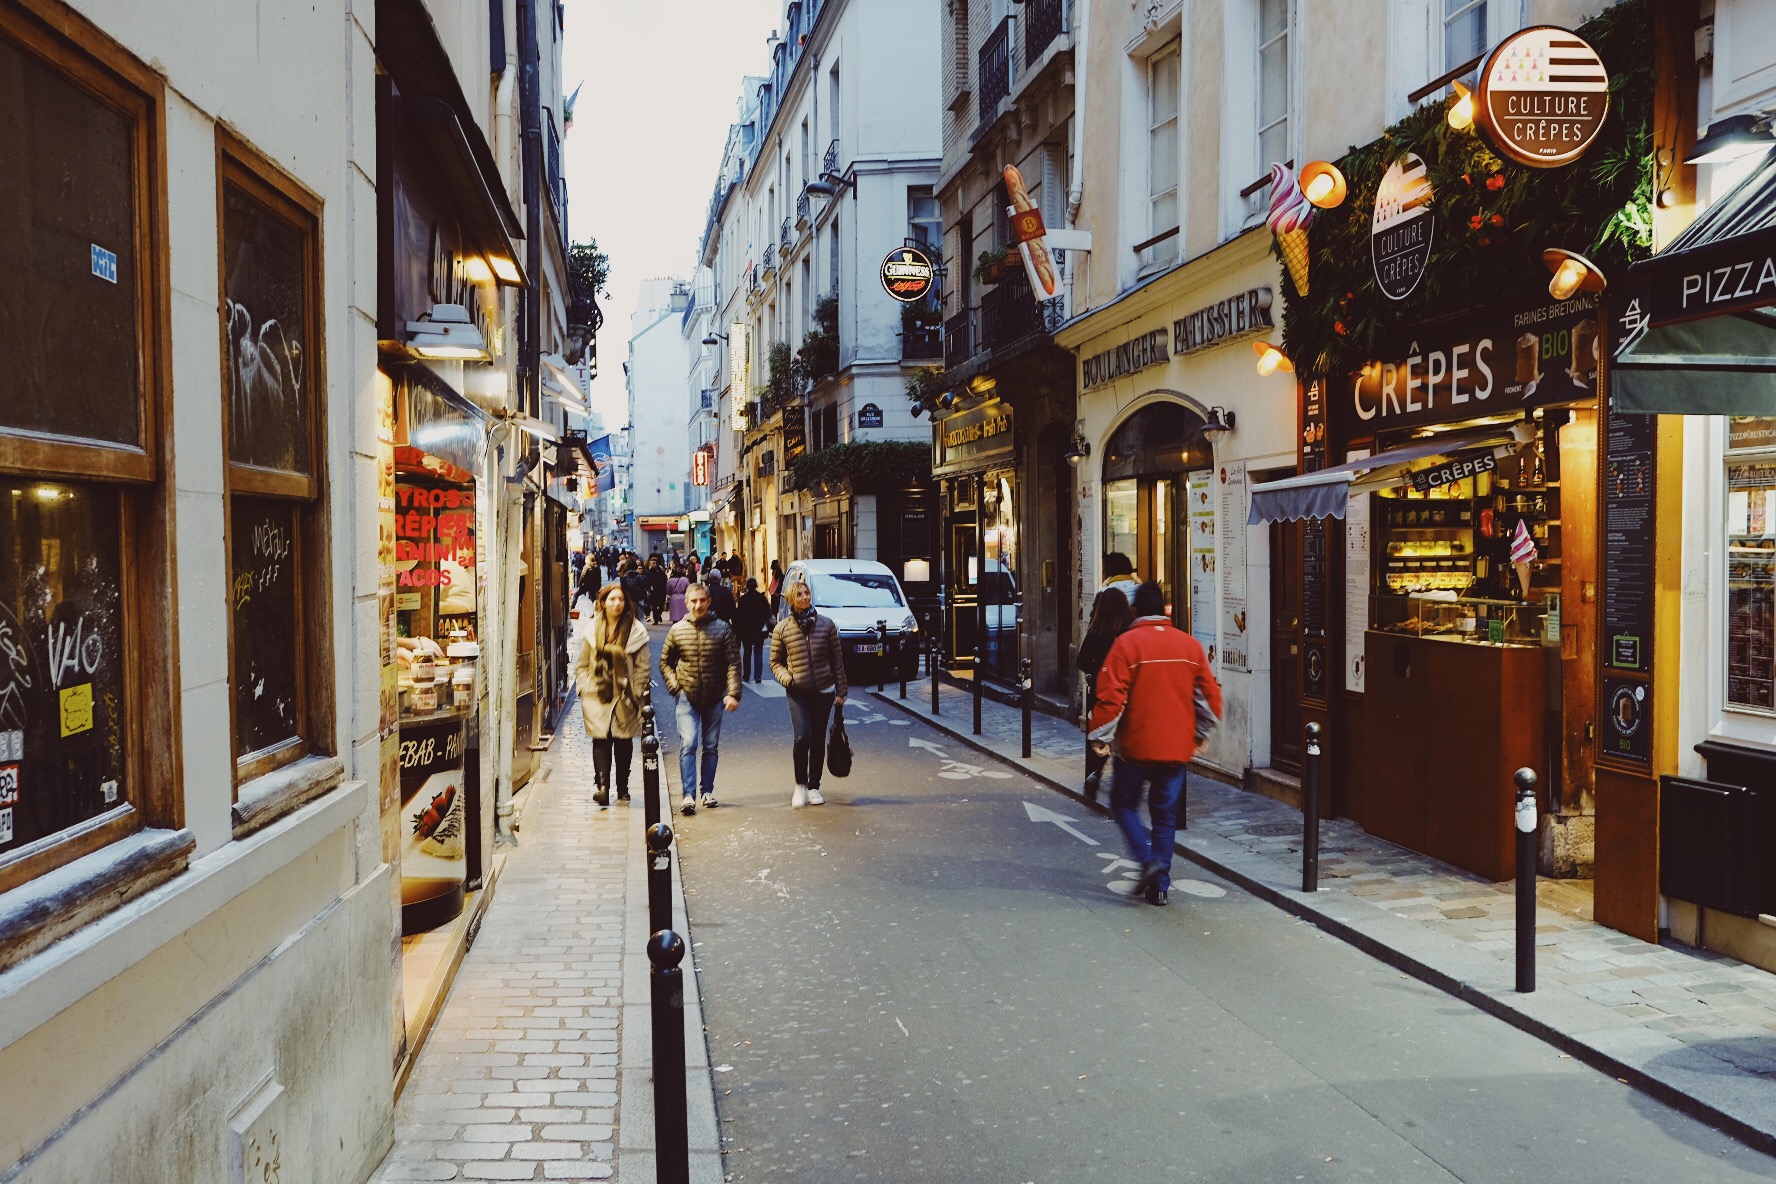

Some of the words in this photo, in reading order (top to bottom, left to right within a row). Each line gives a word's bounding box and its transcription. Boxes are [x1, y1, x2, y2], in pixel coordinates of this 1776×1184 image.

[1508, 96, 1589, 115] CULTURE
[1514, 120, 1582, 141] CRÊPES
[1381, 221, 1423, 255] CULTURE
[885, 264, 931, 278] GUINNESS
[1383, 254, 1420, 284] CRÊPES
[1682, 257, 1776, 309] PIZZA
[1514, 307, 1547, 328] FARINES
[1083, 330, 1166, 390] BOULANGER
[1173, 289, 1270, 356] PATISSIER
[1542, 329, 1569, 360] BIO
[1354, 338, 1494, 421] CRÊPES
[1428, 455, 1495, 486] CRÊPES
[396, 487, 461, 509] YROS
[395, 509, 468, 539] RÊPES
[395, 542, 458, 562] ANINI
[395, 568, 453, 588] ACOS
[399, 737, 435, 769] EBAB
